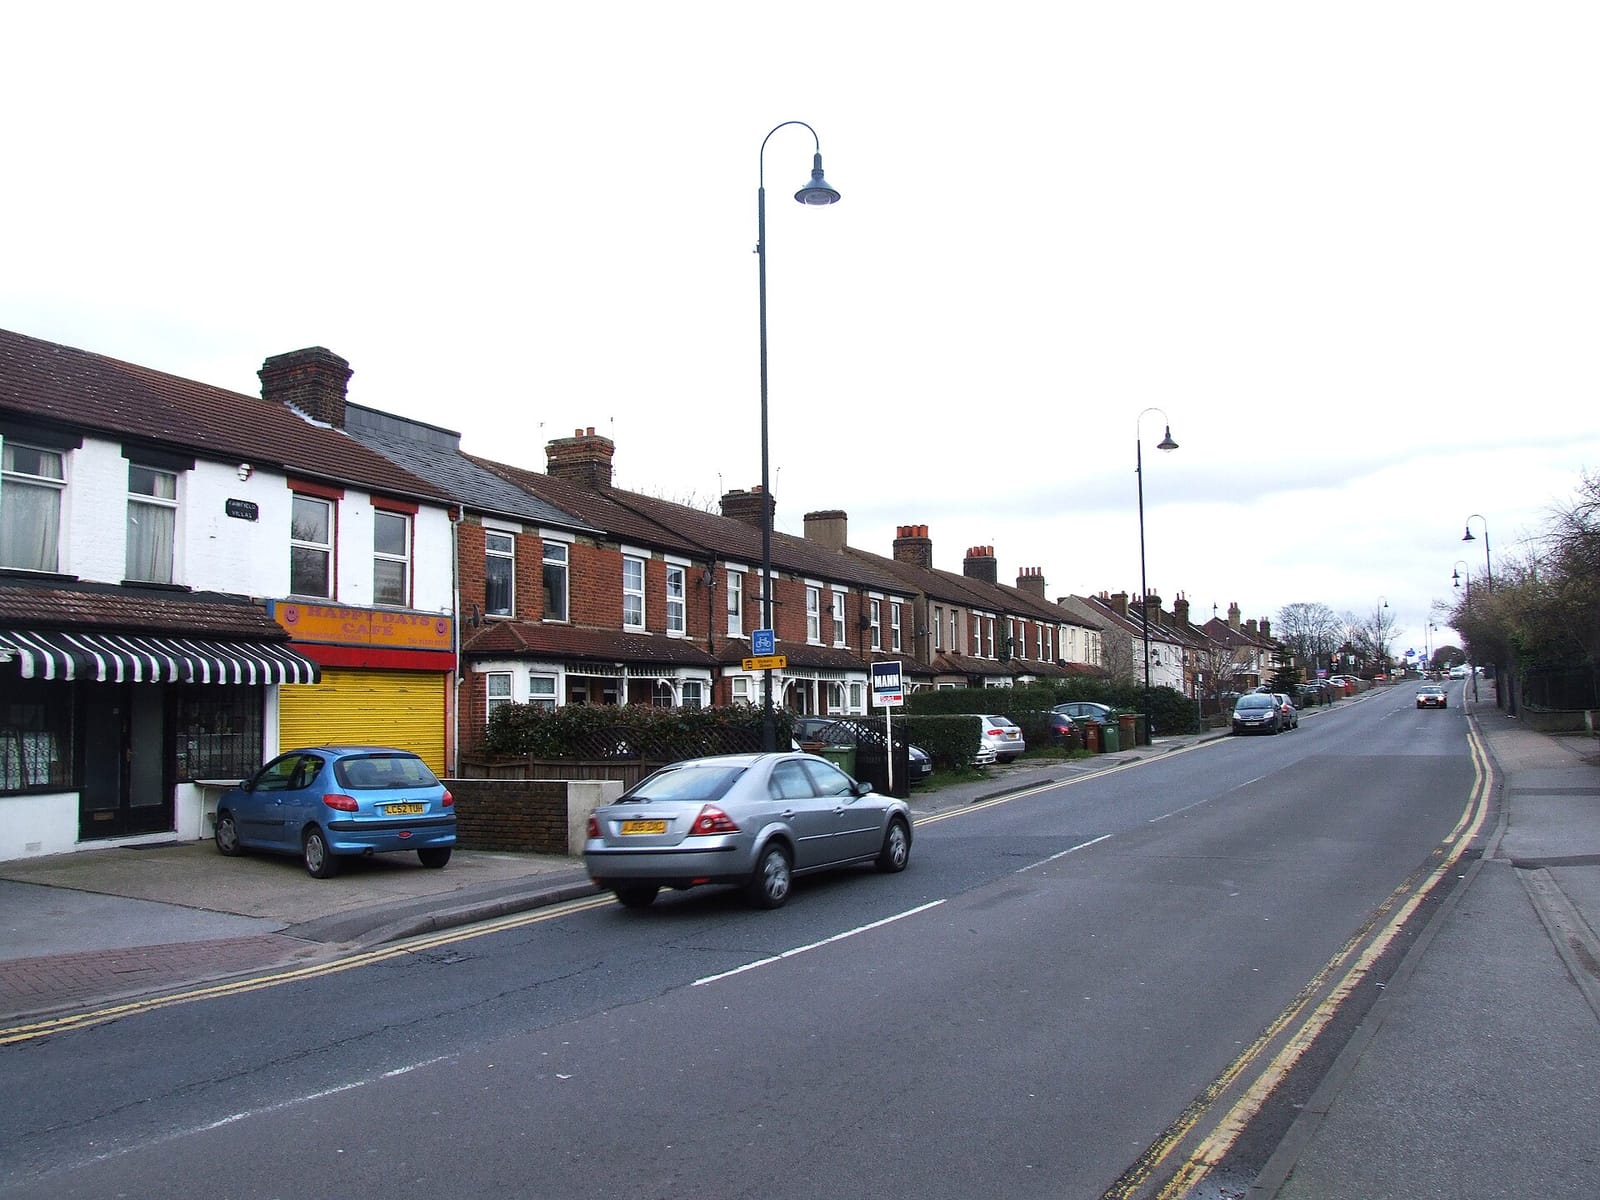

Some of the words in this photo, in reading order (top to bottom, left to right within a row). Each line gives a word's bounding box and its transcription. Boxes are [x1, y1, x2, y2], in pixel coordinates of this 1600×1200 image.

[307, 606, 375, 621] HAPPY
[382, 613, 430, 626] DAYS
[874, 674, 900, 688] MANN
